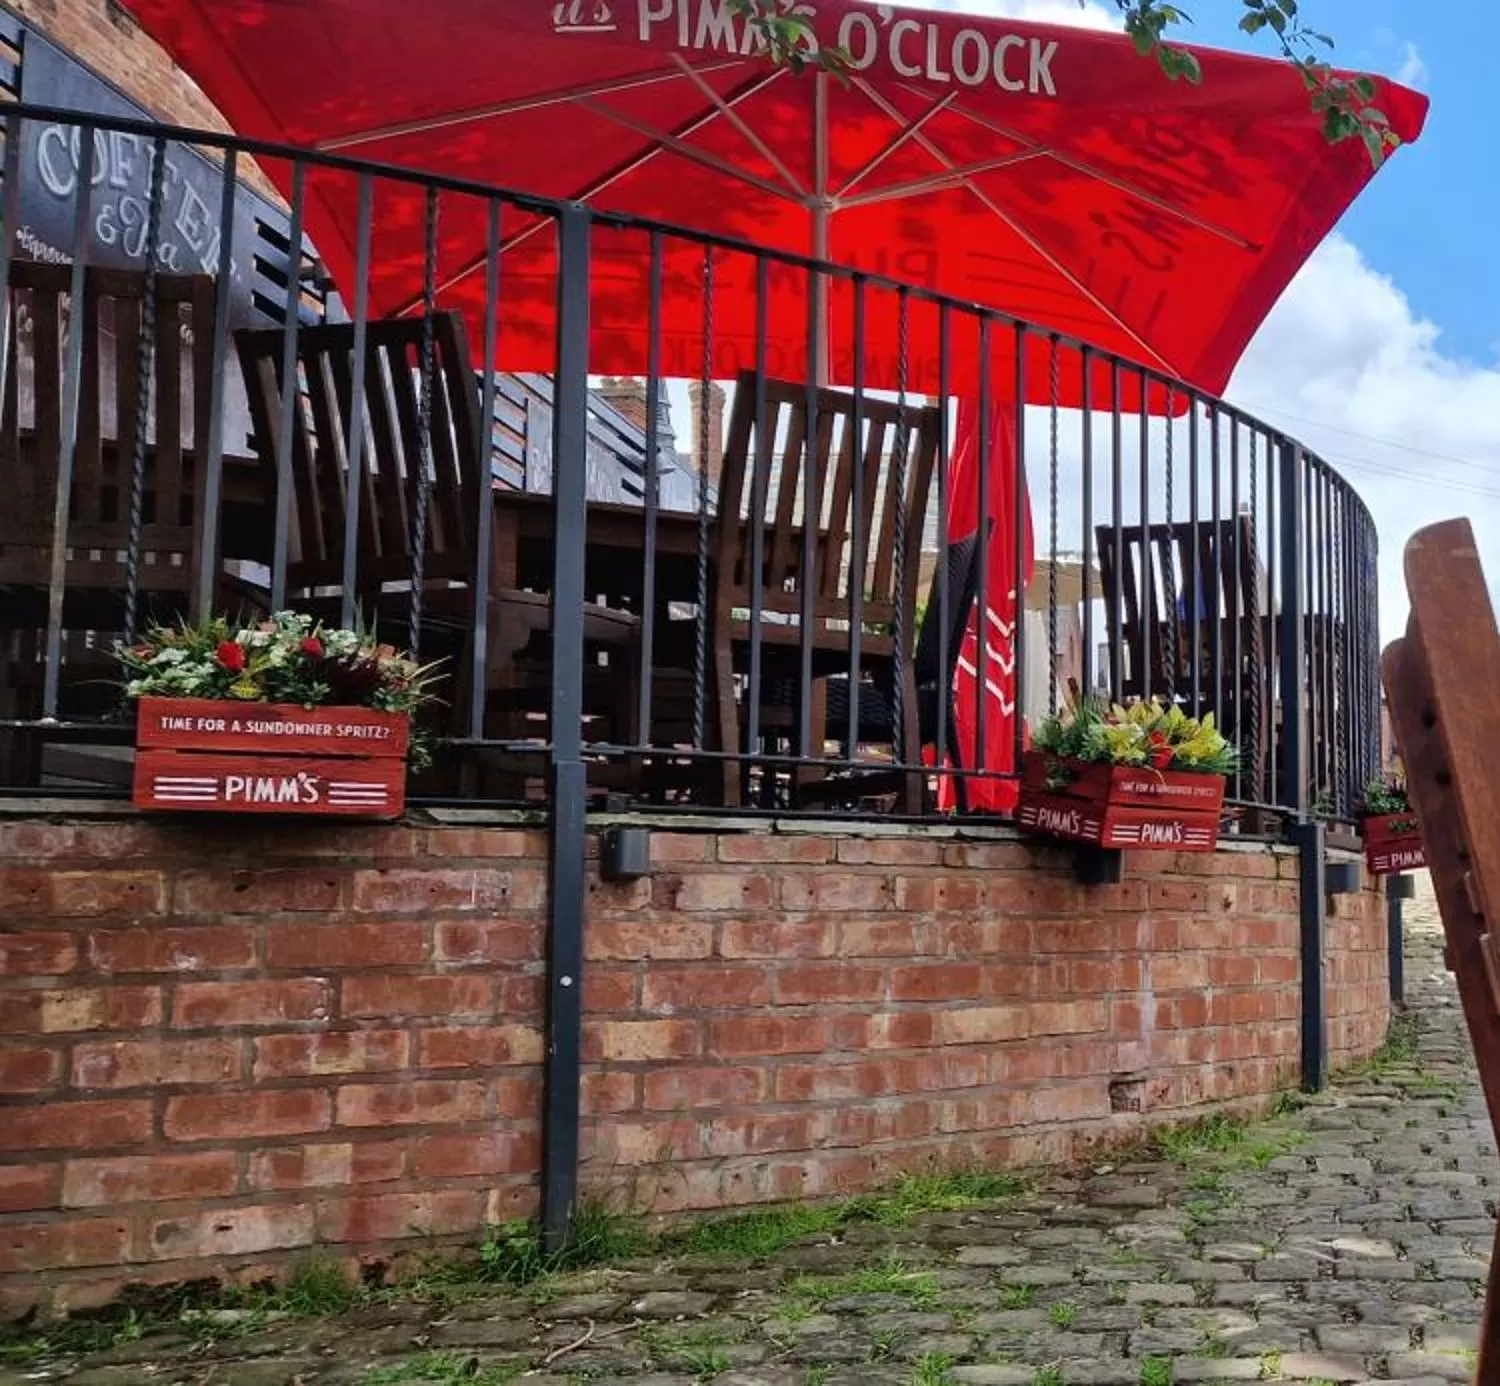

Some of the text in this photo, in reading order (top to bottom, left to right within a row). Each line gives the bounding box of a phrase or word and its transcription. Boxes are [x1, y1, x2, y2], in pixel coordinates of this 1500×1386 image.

[837, 4, 1060, 96] O'CLOCK
[119, 195, 181, 272] Ta
[160, 716, 390, 739] TIME FOR A SUNDOWNER SPRITZ?
[224, 771, 320, 804] PIMM'S
[1036, 807, 1082, 834] PIMM'S
[1140, 821, 1185, 844] PIMM'S
